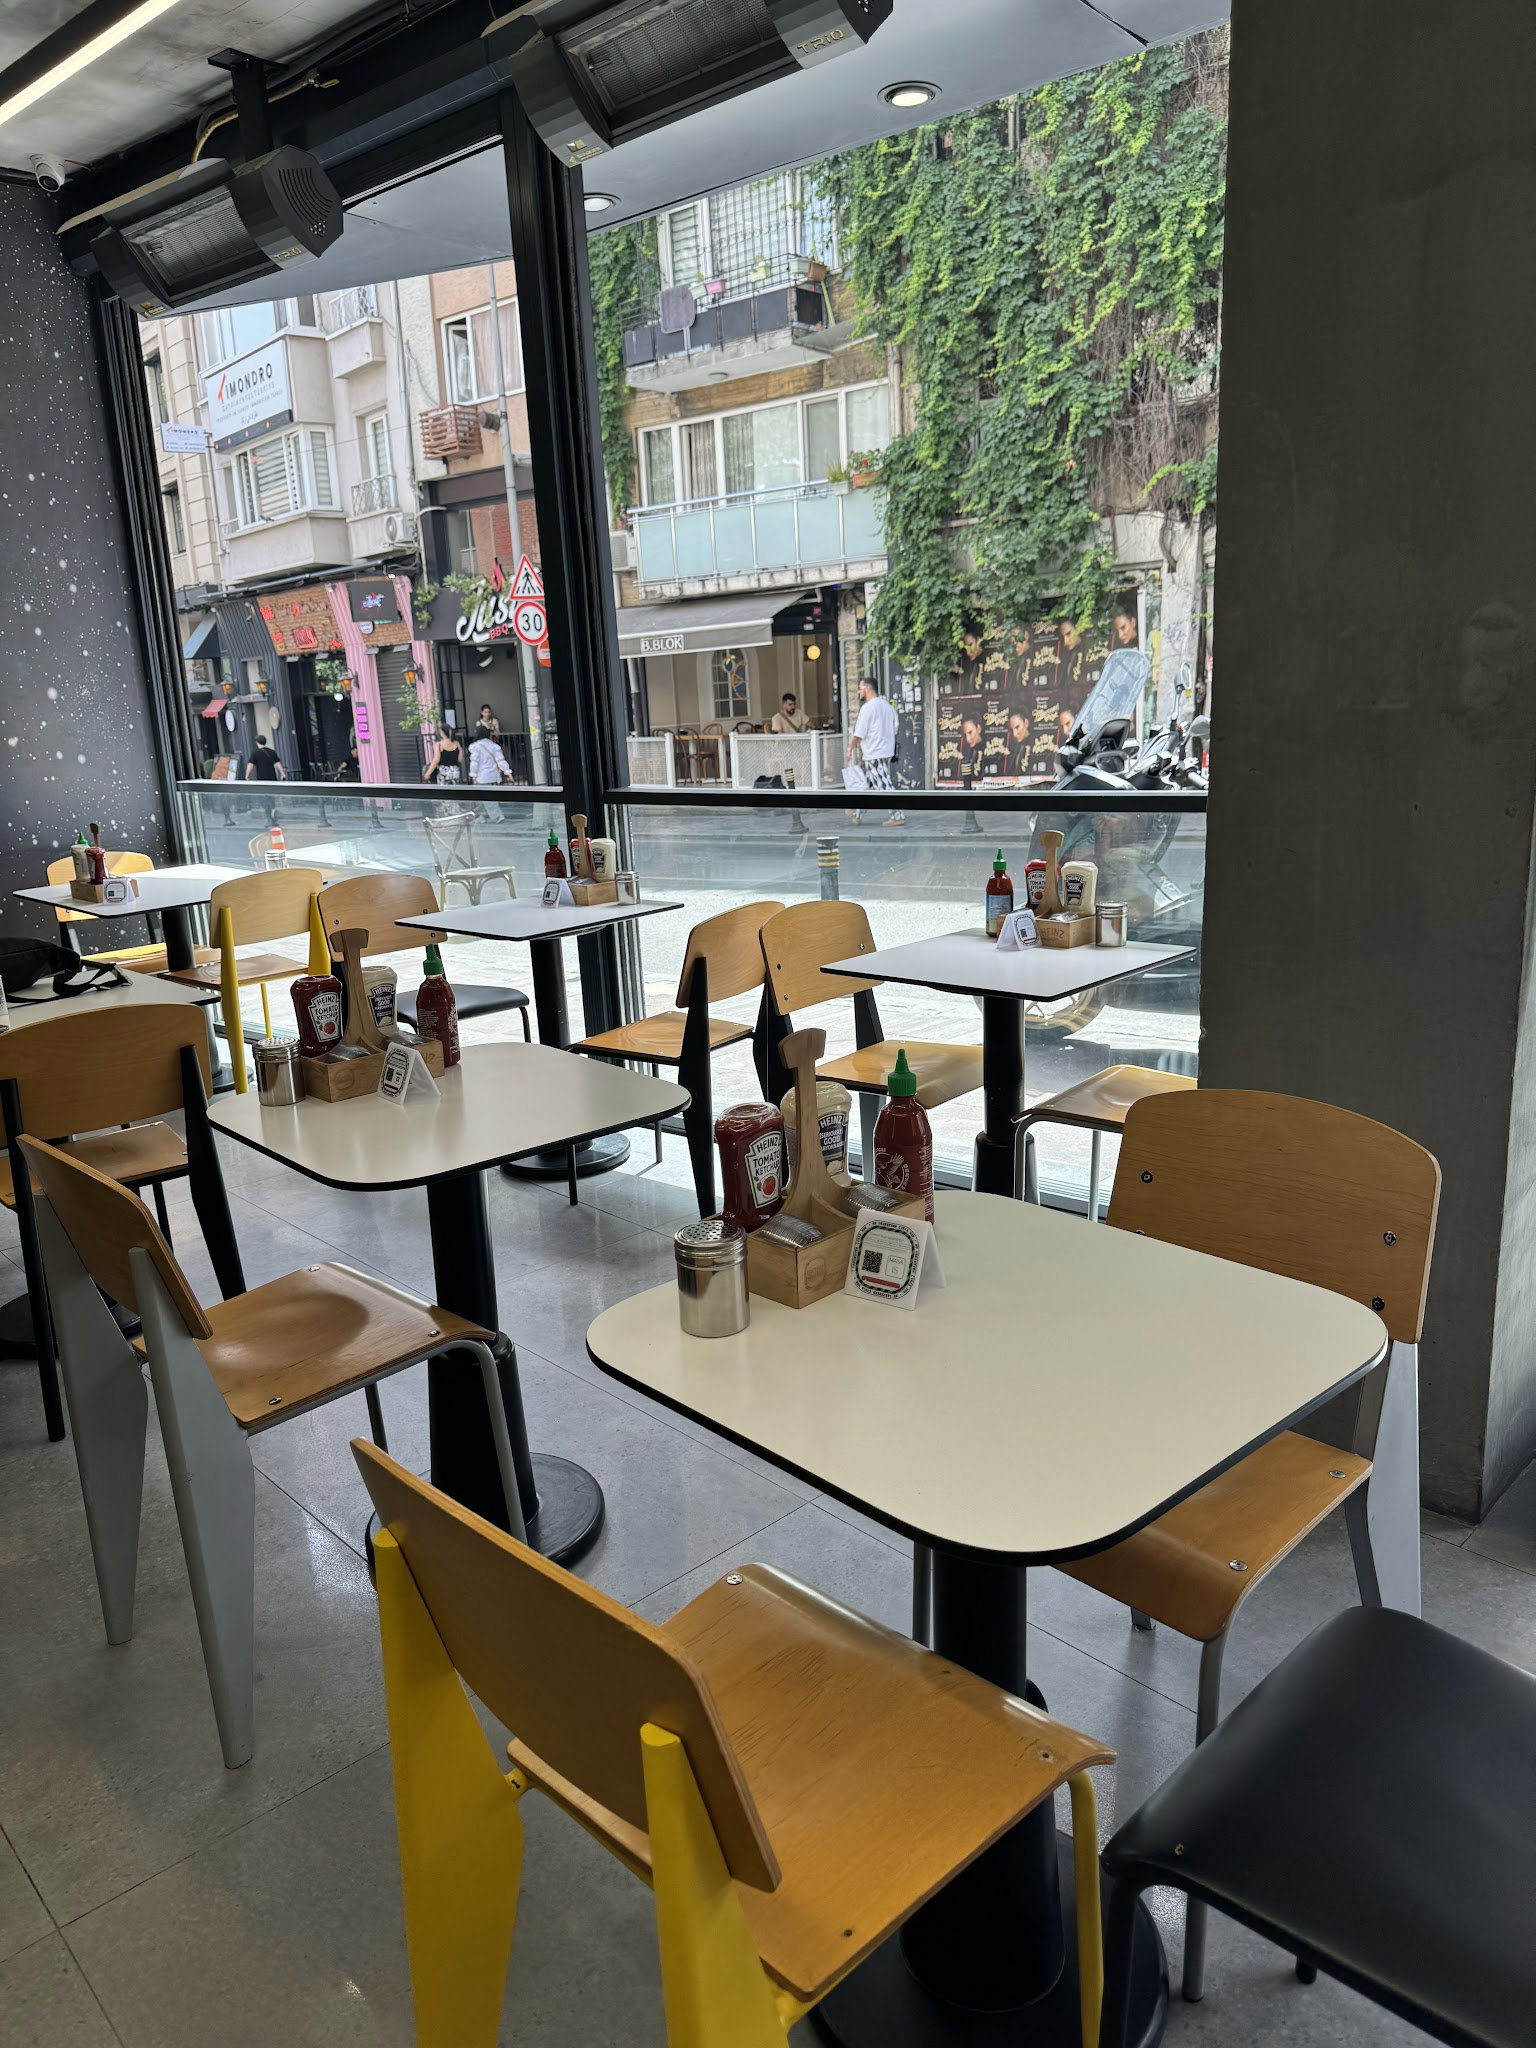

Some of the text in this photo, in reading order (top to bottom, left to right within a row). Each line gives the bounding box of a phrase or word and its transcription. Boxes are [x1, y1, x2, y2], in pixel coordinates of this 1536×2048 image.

[522, 613, 543, 632] 30
[489, 623, 510, 639] BBQ
[641, 637, 682, 652] B.BLOK
[316, 996, 335, 1006] HEINZ
[315, 1004, 339, 1015] TOMATO
[819, 1115, 843, 1128] HEINZ
[756, 1136, 779, 1153] HEINZ
[823, 1135, 841, 1145] GOOD
[753, 1149, 781, 1168] TOMATO
